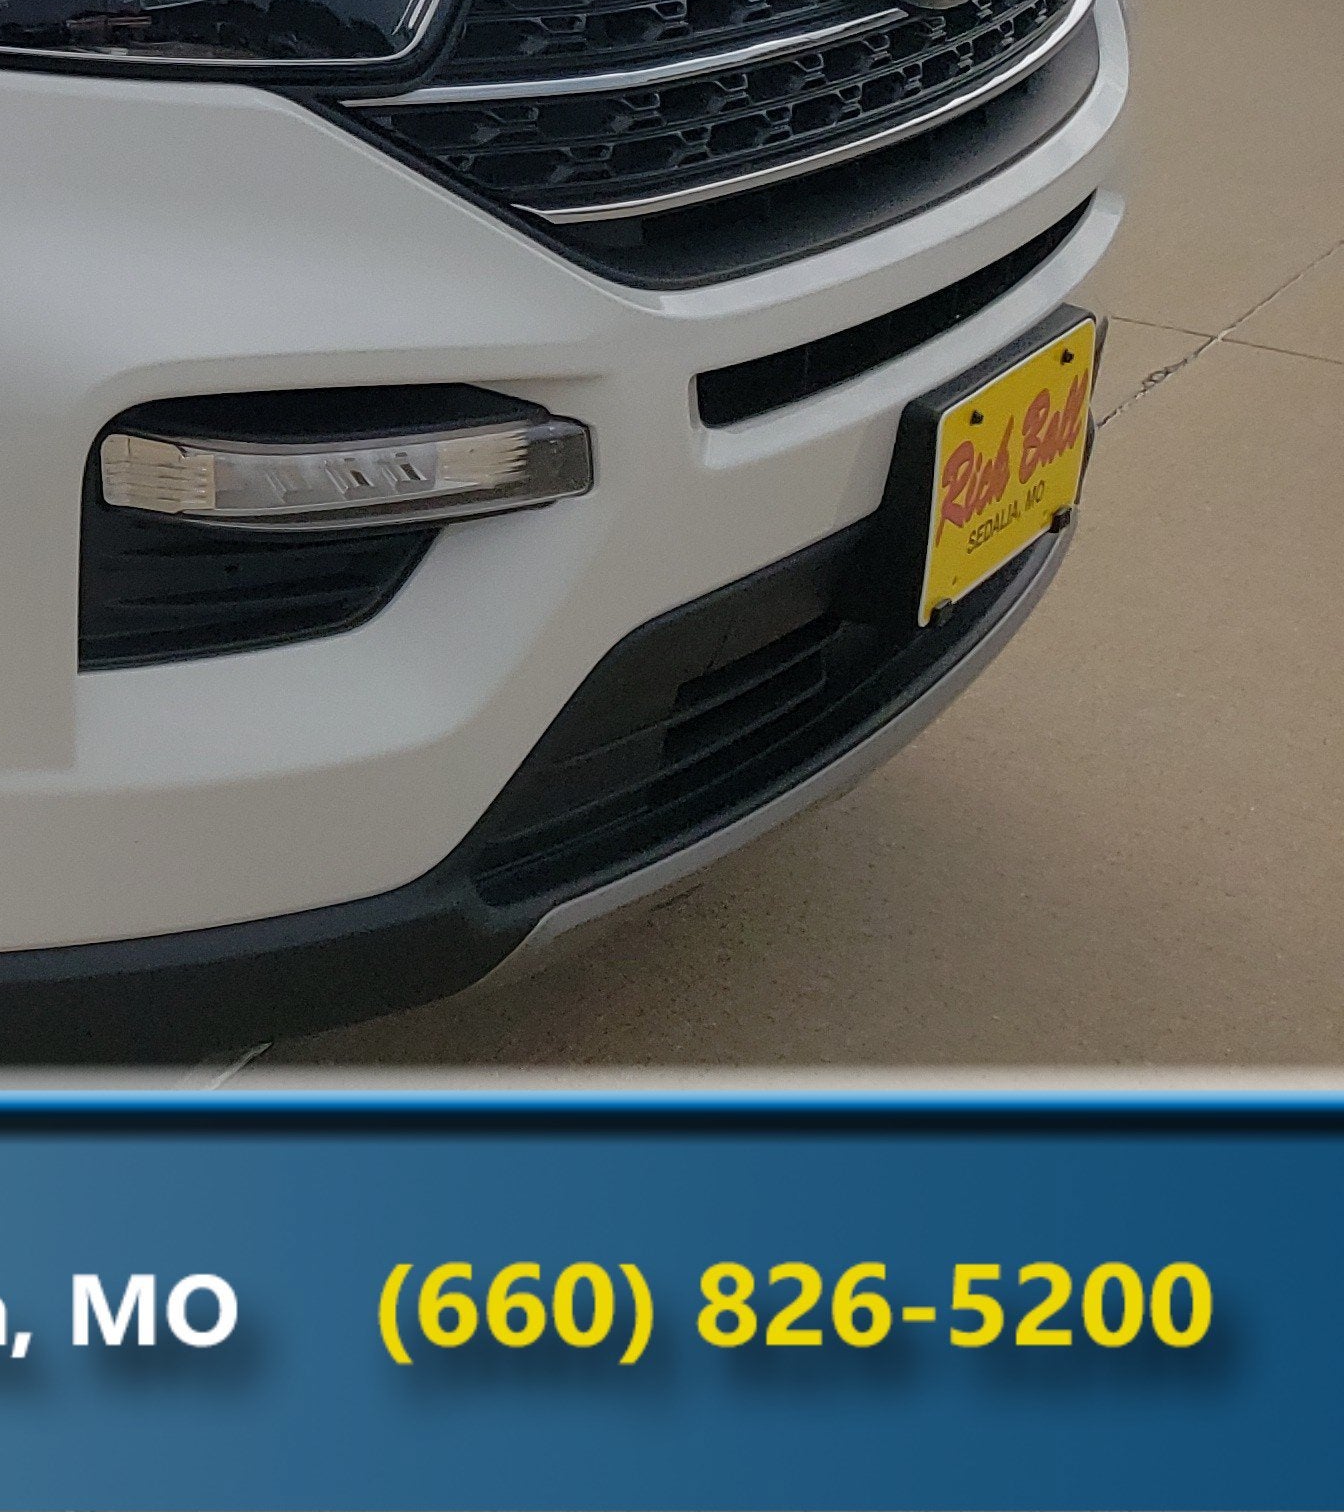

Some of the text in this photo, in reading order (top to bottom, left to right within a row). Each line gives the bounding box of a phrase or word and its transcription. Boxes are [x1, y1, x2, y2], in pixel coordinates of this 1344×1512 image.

[935, 368, 1089, 547] Rick Ball
[967, 480, 1046, 554] SEDALIA, MO
